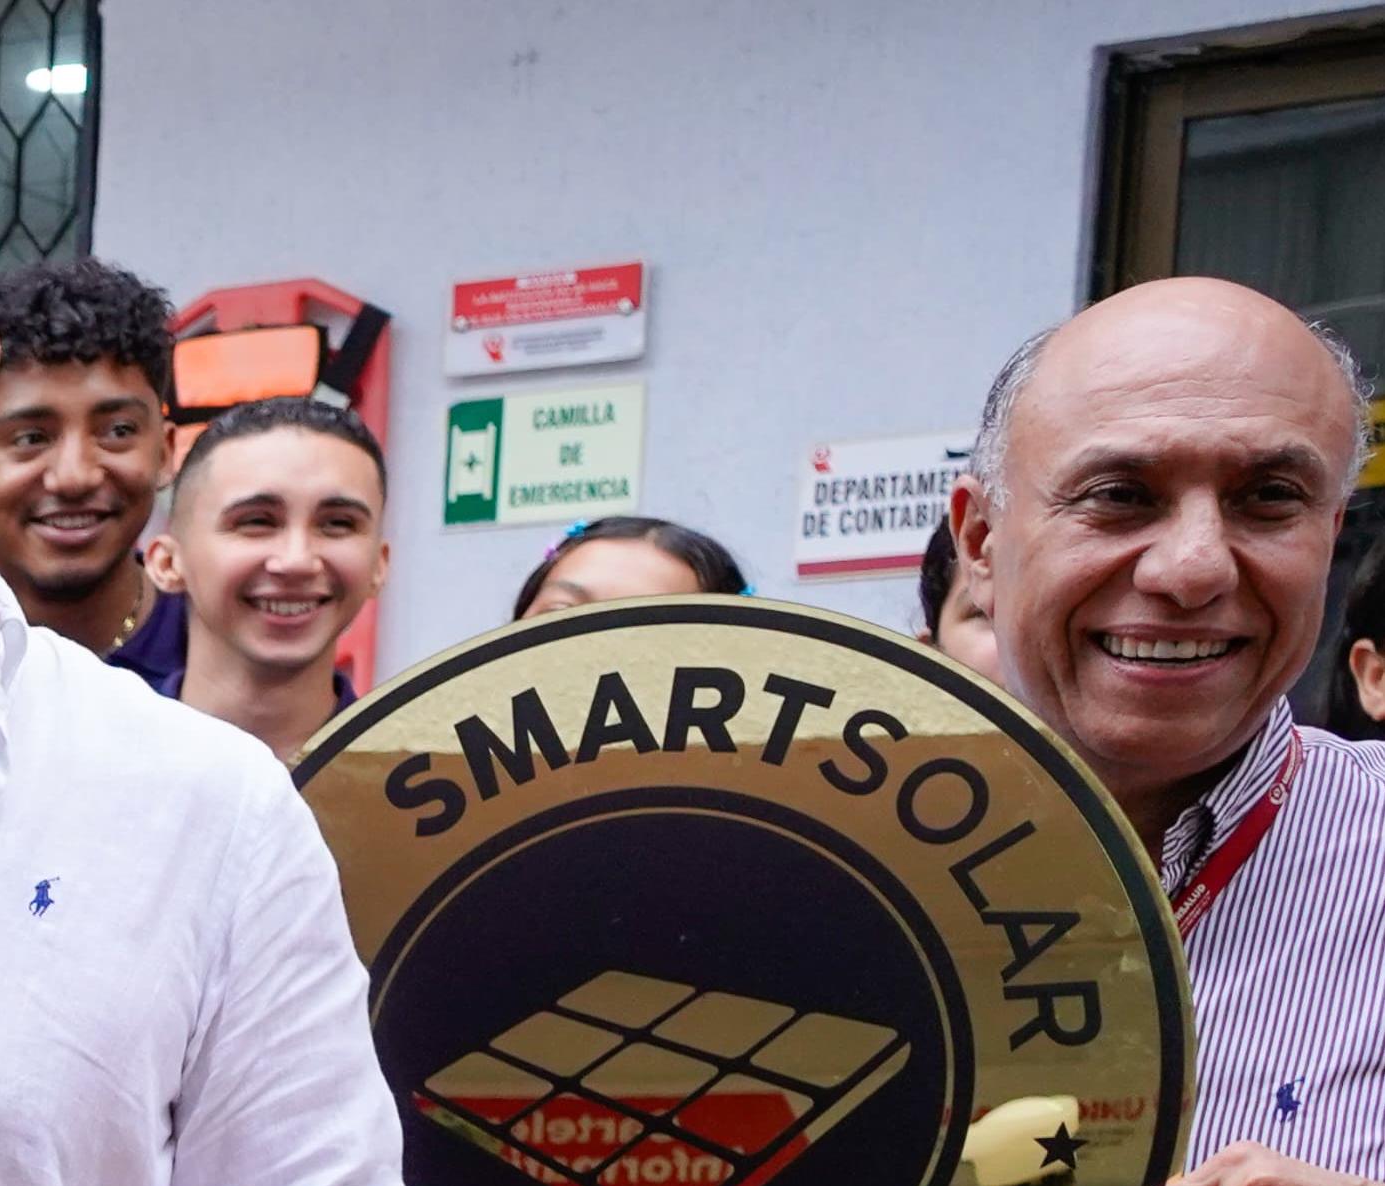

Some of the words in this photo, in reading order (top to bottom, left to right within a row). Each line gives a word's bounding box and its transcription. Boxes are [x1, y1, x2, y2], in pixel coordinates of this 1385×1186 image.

[533, 402, 615, 430] CAMILLA
[559, 444, 582, 466] DE
[509, 475, 630, 507] EMERGENCIA
[804, 511, 831, 538] DE
[385, 665, 1102, 1053] SMARTSOLAR
